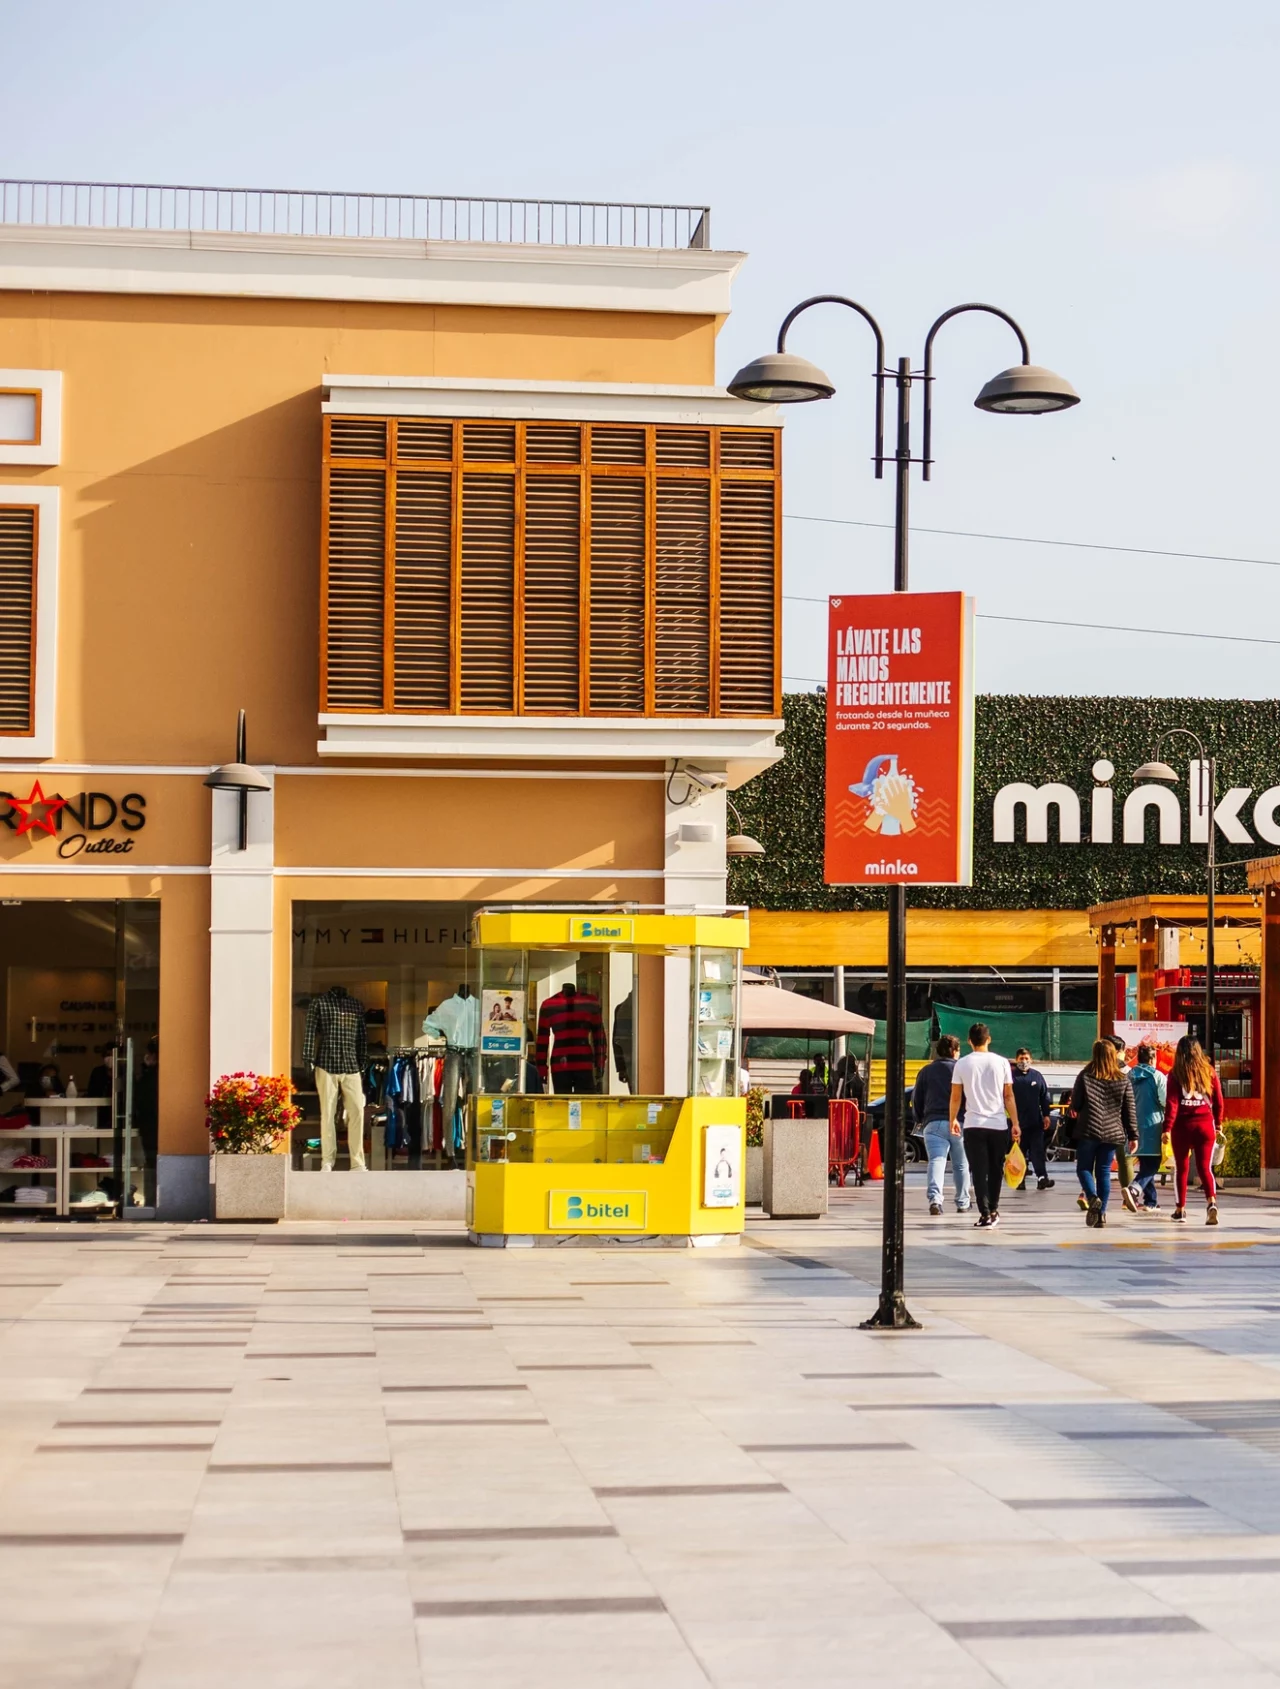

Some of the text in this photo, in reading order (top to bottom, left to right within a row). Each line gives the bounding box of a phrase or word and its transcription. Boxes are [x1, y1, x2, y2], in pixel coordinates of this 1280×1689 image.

[837, 626, 921, 655] LÁVATE LAS
[837, 656, 889, 682] MANOS
[836, 681, 951, 706] FRECUENTEMENTE
[836, 710, 950, 719] frotando desde la muñeca
[836, 722, 870, 730] durante
[872, 721, 885, 730] 20
[58, 834, 135, 859] Outlet
[865, 860, 918, 875] minka
[587, 1204, 629, 1218] bitel
